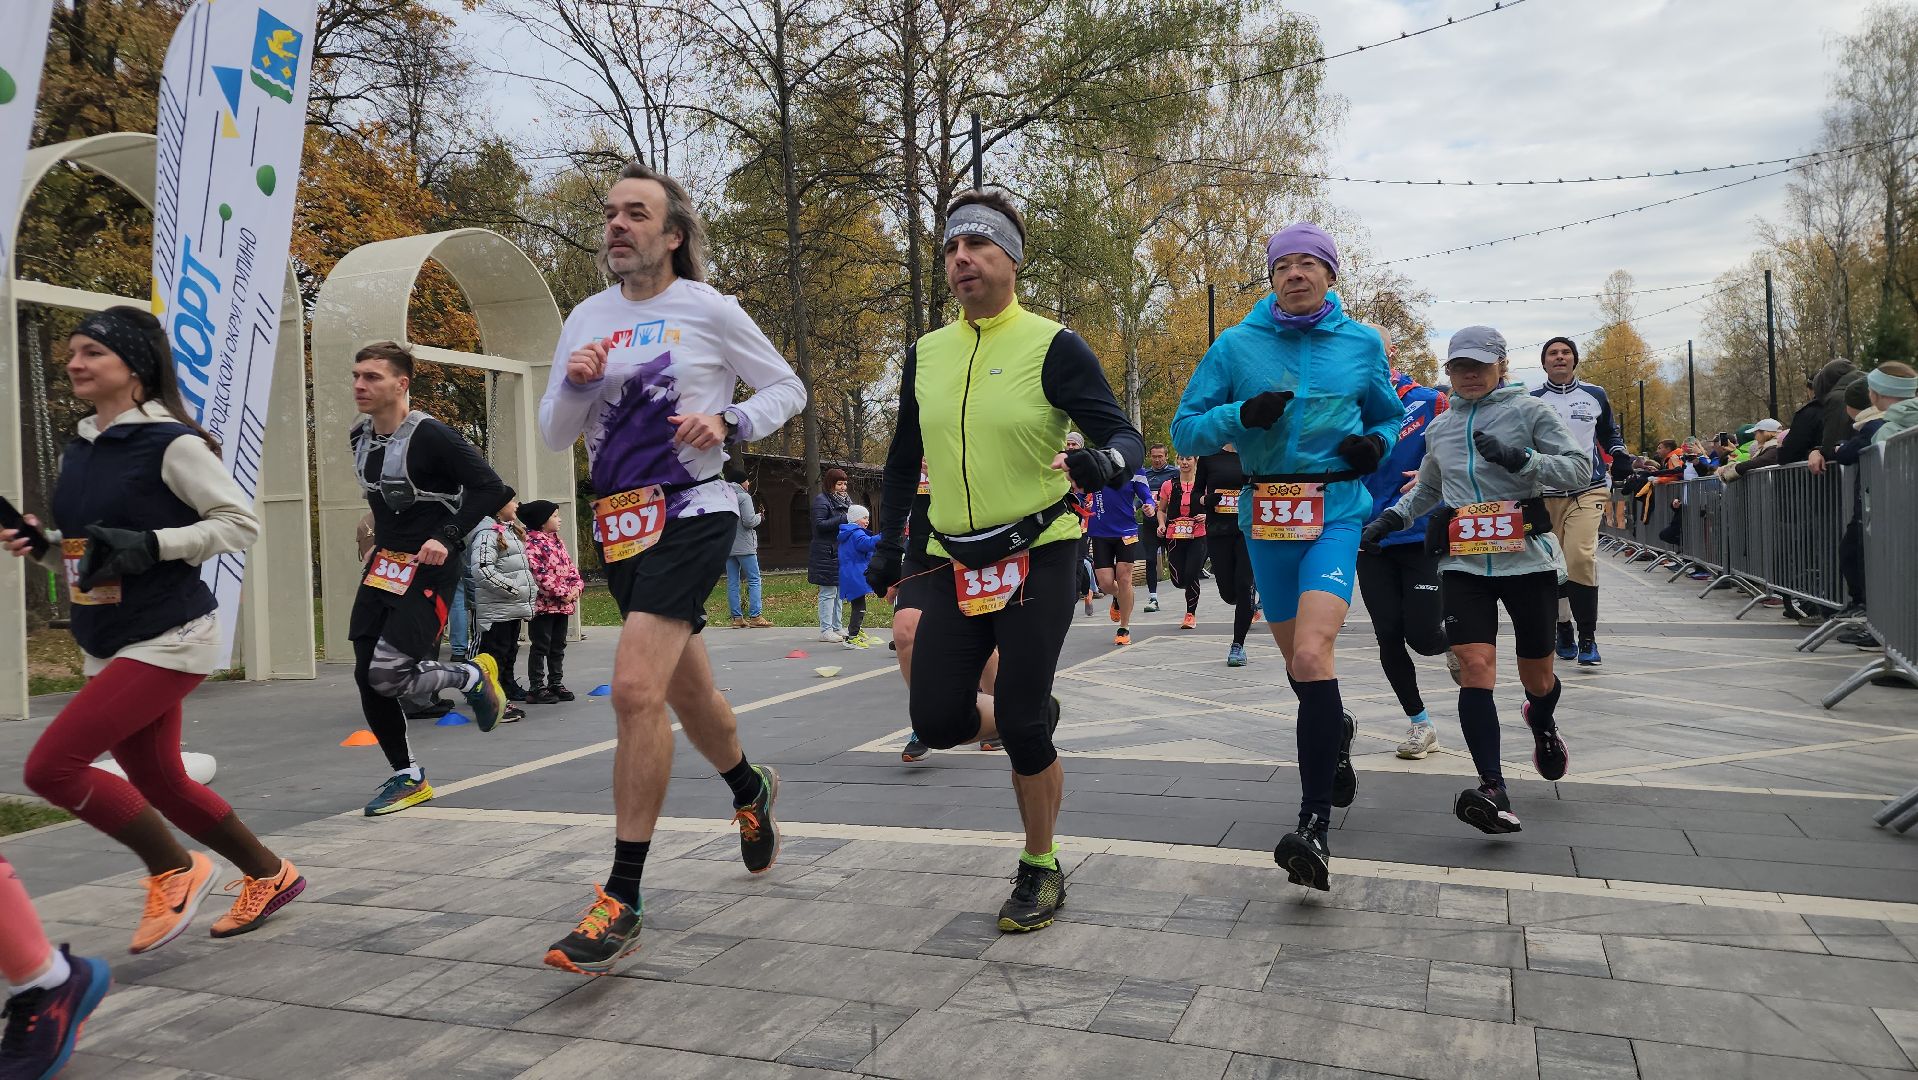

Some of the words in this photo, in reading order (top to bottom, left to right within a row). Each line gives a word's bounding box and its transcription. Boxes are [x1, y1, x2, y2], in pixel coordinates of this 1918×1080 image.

[949, 222, 996, 237] TERREX
[233, 226, 258, 303] СТУПИНО
[225, 298, 243, 354] ОКРУГ
[209, 349, 234, 446] ОРОДСКОЙ
[605, 504, 659, 542] 307
[1259, 500, 1314, 524] 334
[1458, 515, 1514, 540] 335
[374, 558, 413, 583] 304
[963, 561, 1022, 596] 354
